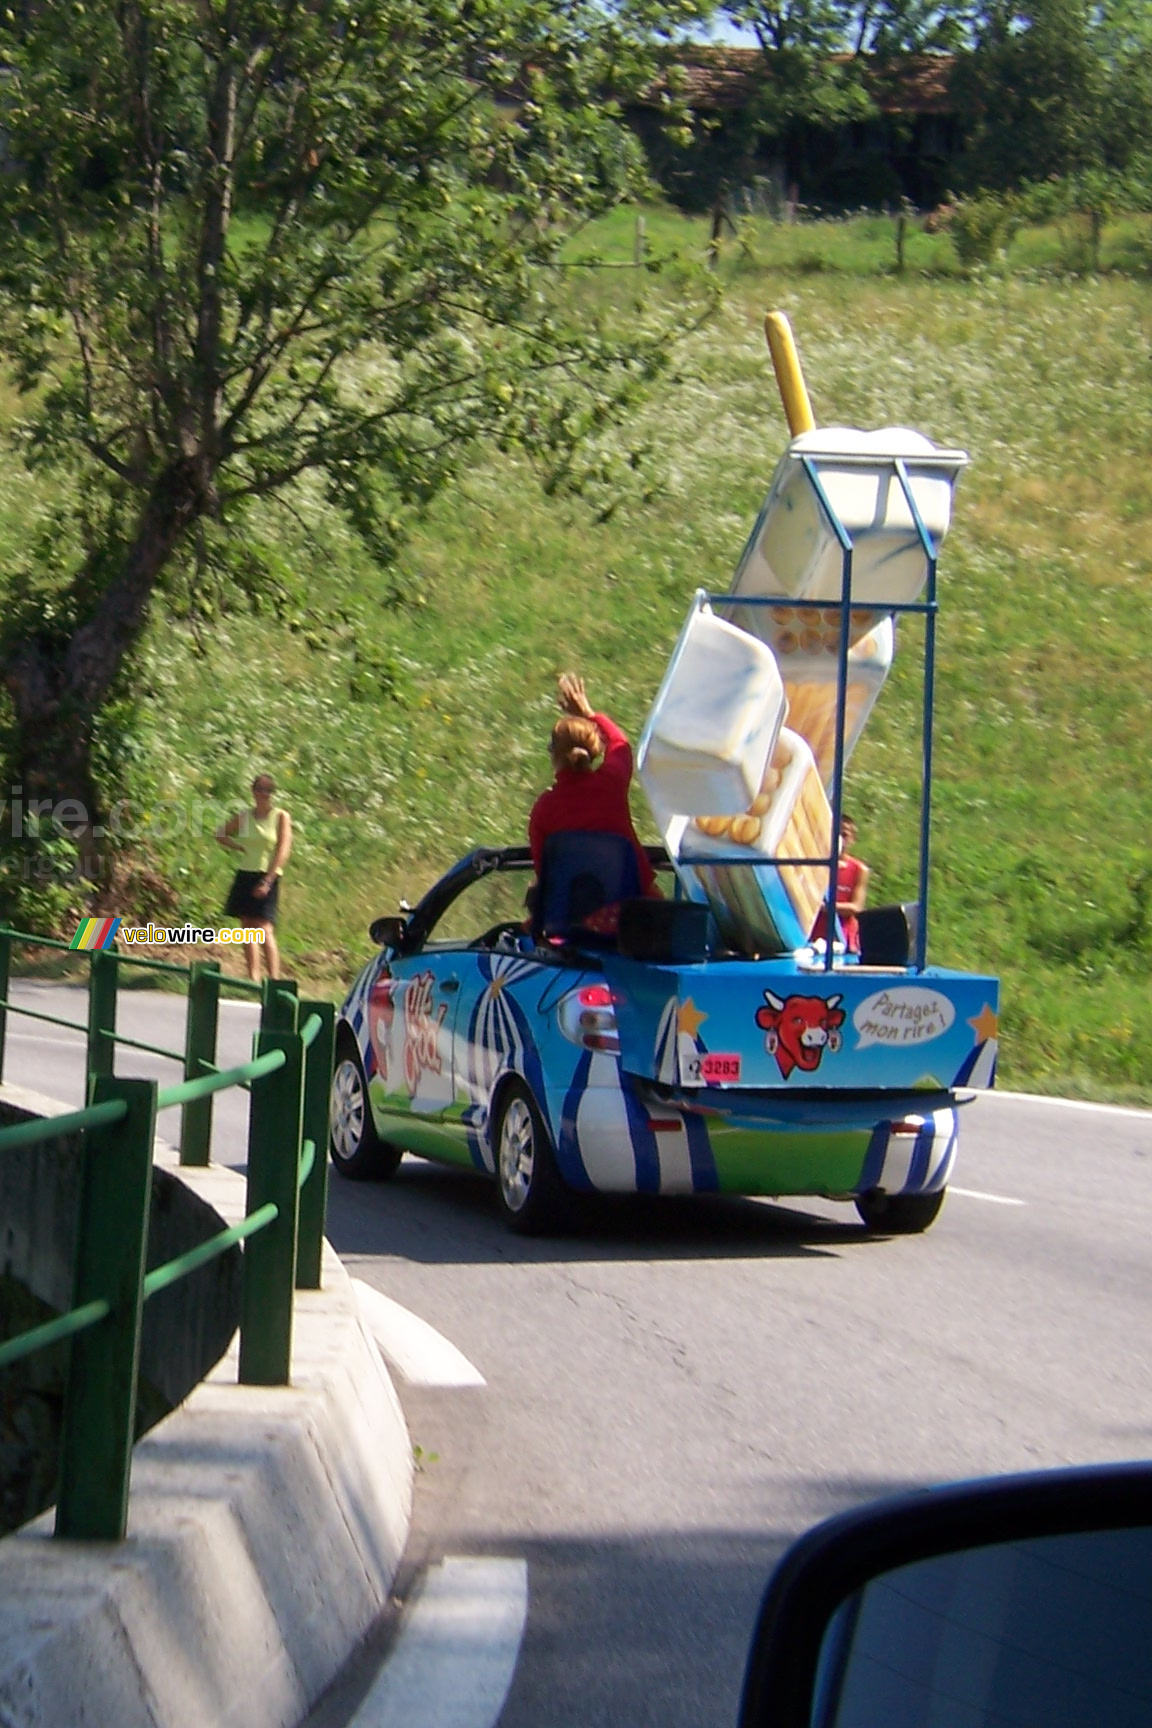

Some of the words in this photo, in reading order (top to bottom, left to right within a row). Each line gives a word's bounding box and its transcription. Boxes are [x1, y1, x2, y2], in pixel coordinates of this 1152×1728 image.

[872, 992, 940, 1025] Partagez
[860, 1020, 898, 1039] mon
[903, 1022, 936, 1040] rire
